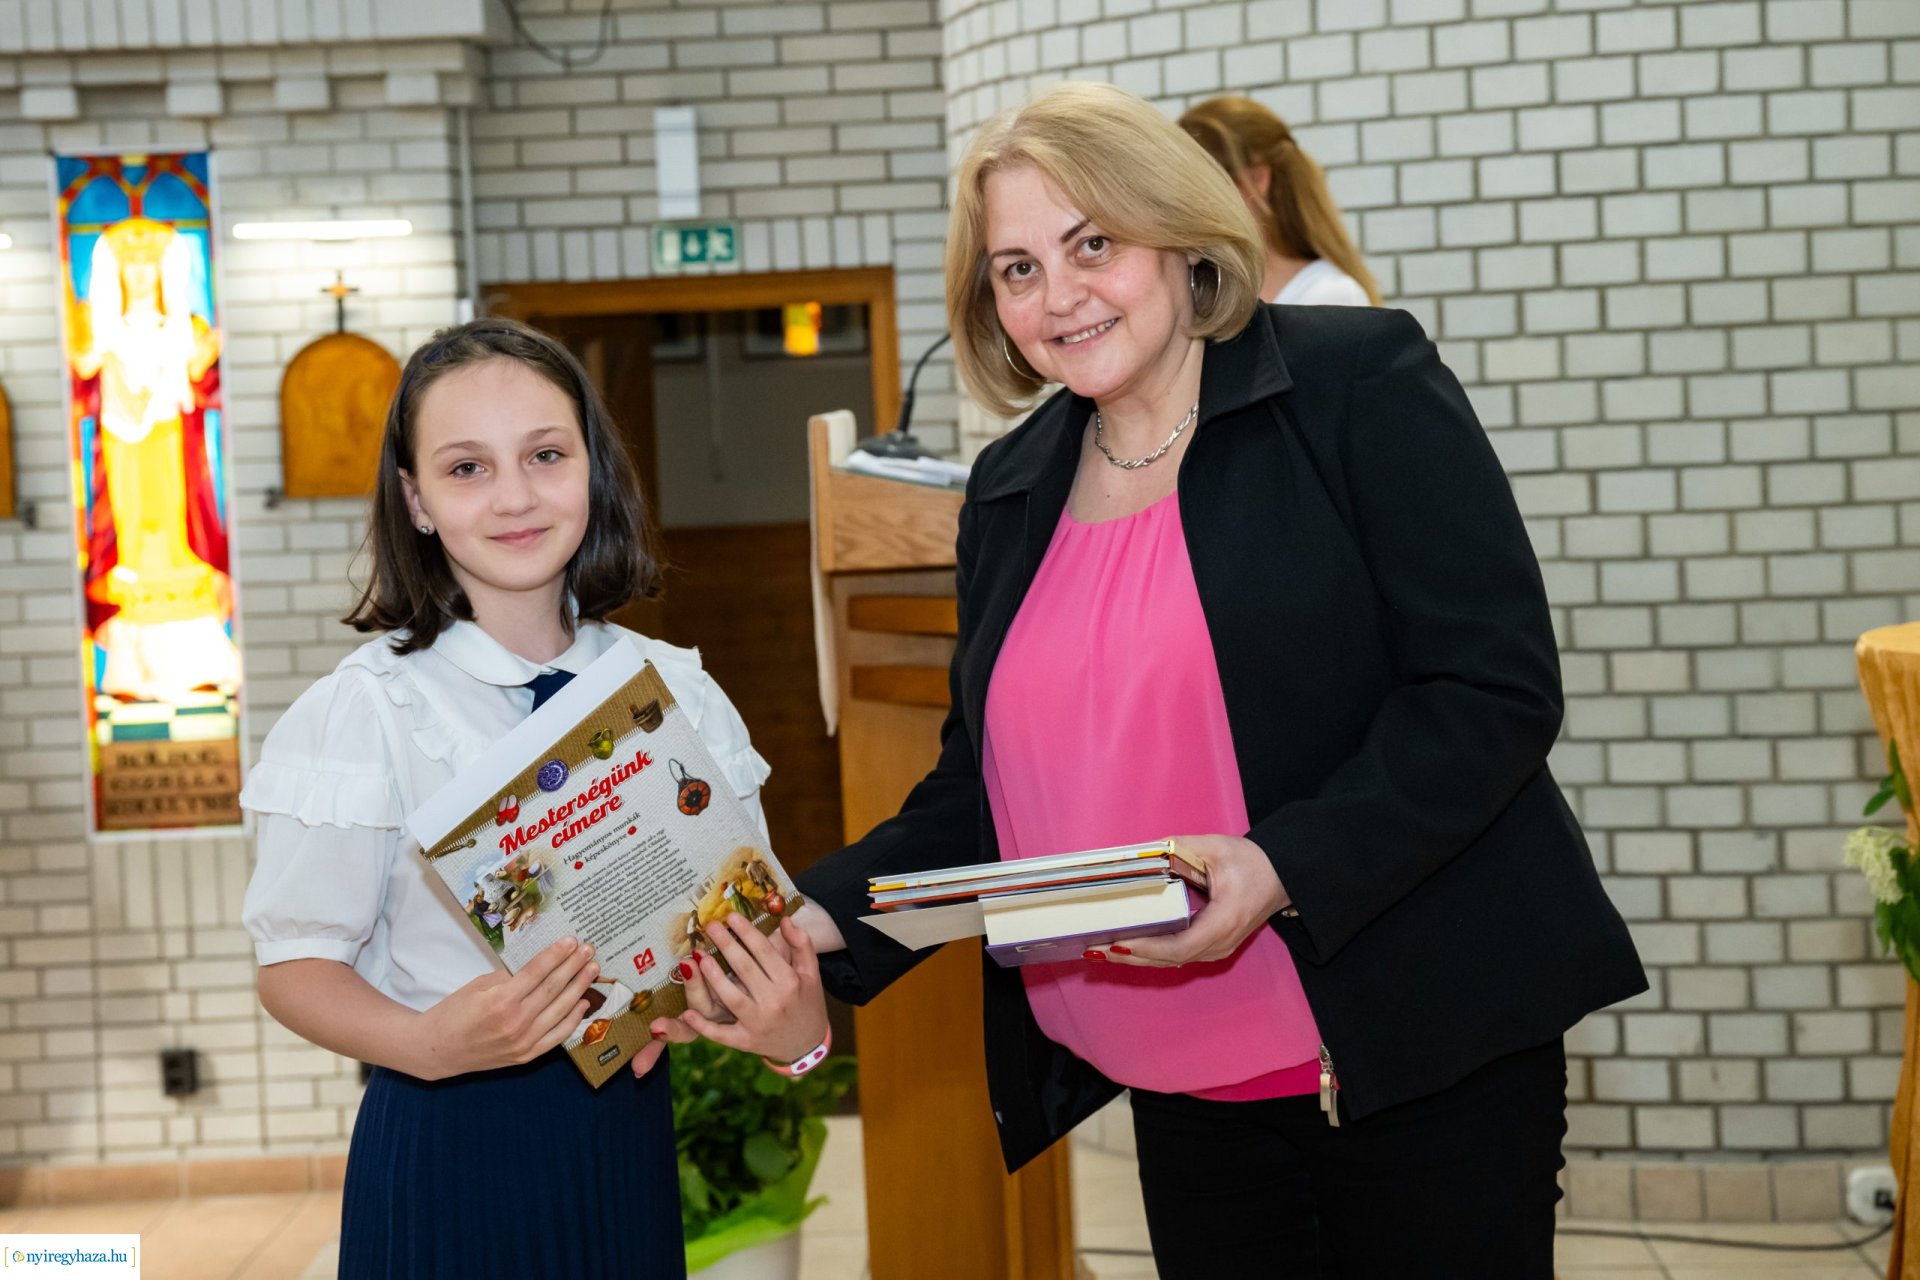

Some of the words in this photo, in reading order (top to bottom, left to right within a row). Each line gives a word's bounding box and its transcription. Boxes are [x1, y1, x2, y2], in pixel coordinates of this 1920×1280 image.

[499, 751, 653, 856] Mesterségünk
[551, 795, 622, 849] címere
[563, 831, 613, 865] Hagyományos
[613, 811, 641, 833] munkák
[584, 833, 627, 863] képeskönyve
